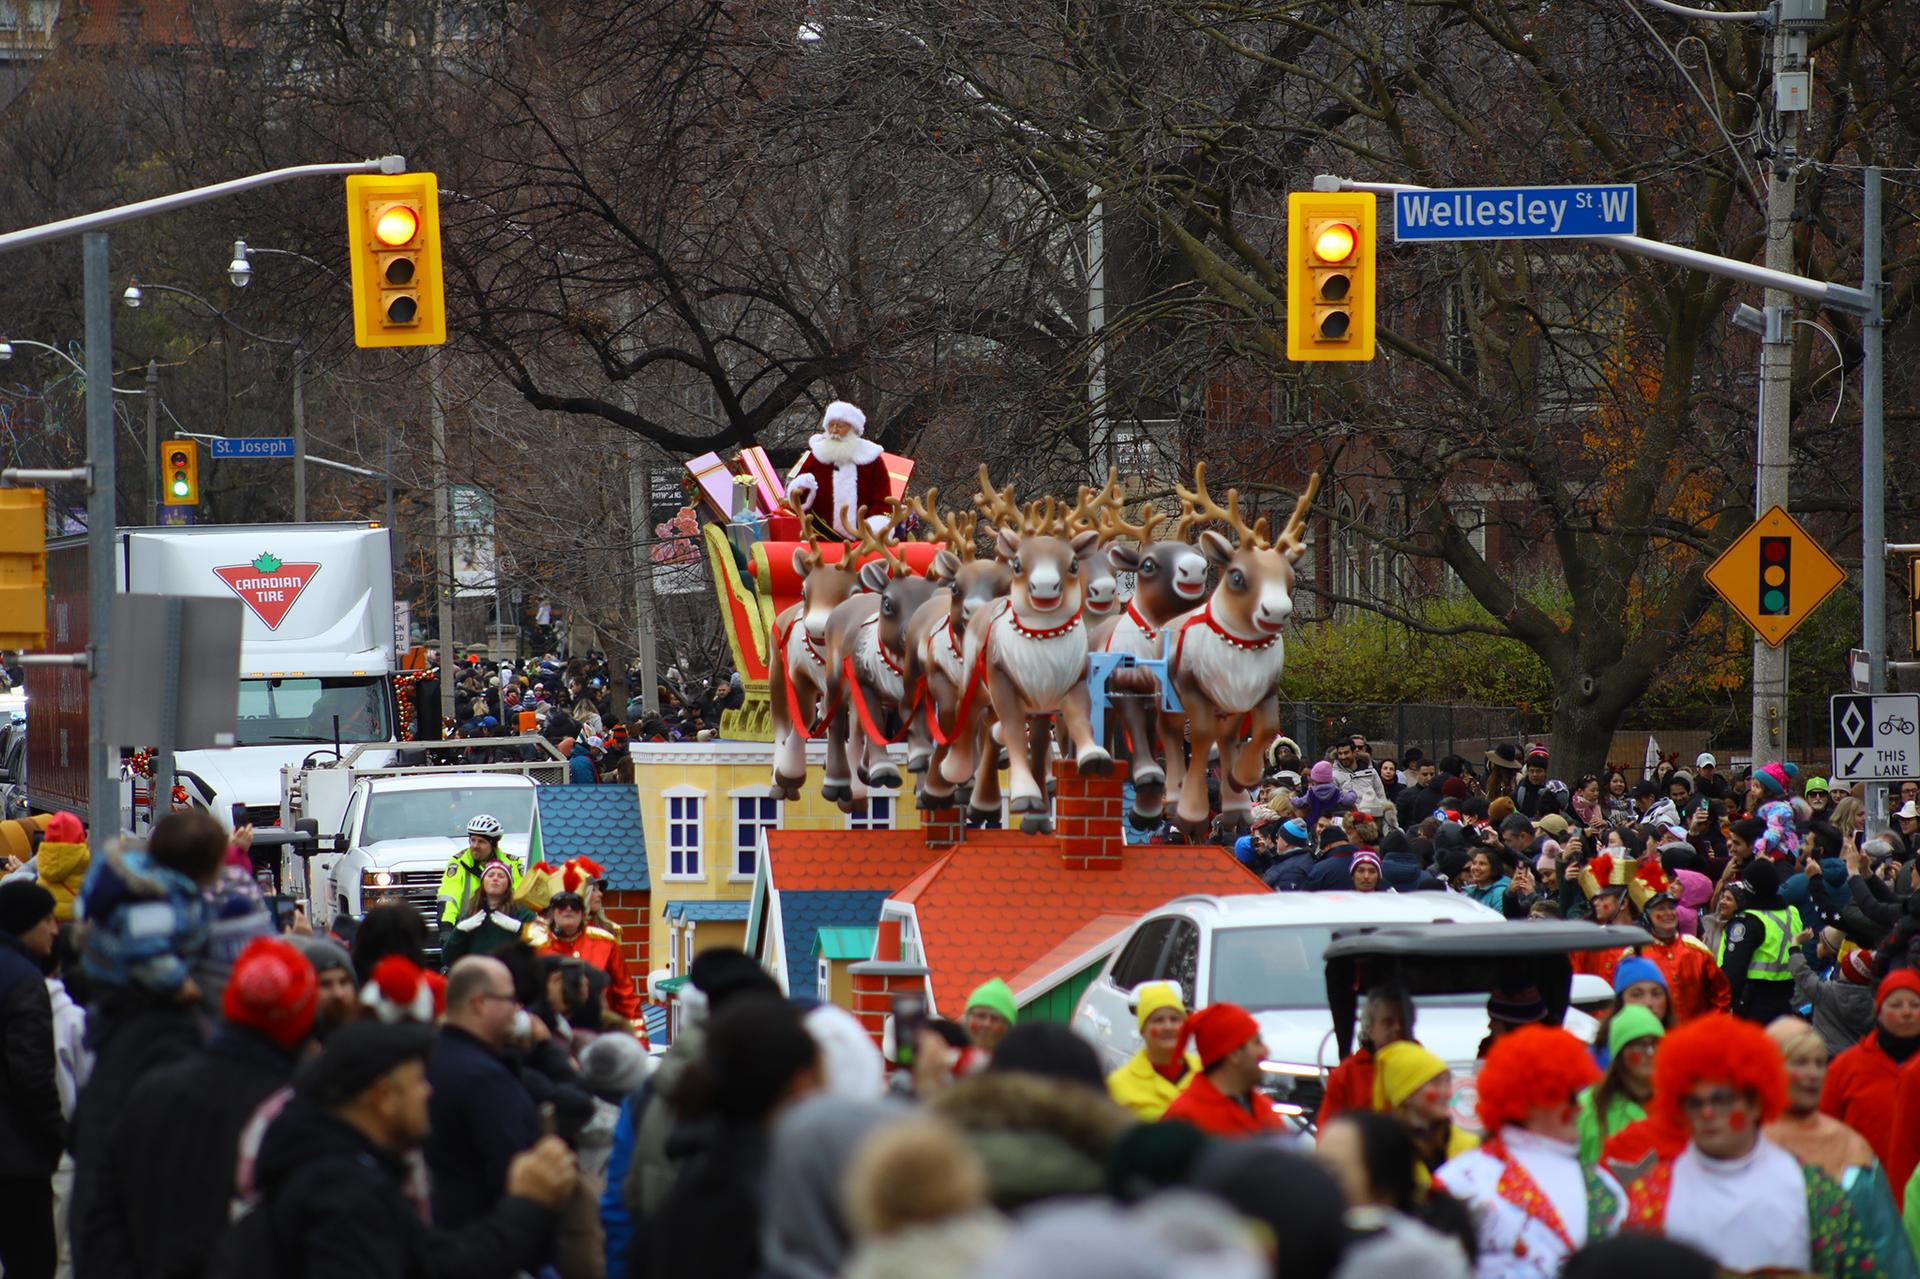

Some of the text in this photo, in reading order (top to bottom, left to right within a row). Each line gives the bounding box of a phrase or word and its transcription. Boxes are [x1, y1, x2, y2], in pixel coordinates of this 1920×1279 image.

[1402, 190, 1629, 233] Wellesley St W
[216, 439, 287, 456] St. Joseph
[235, 577, 302, 590] CANADIAN
[255, 590, 284, 603] TIRE
[1877, 750, 1906, 762] THIS
[1874, 764, 1909, 777] LANE
